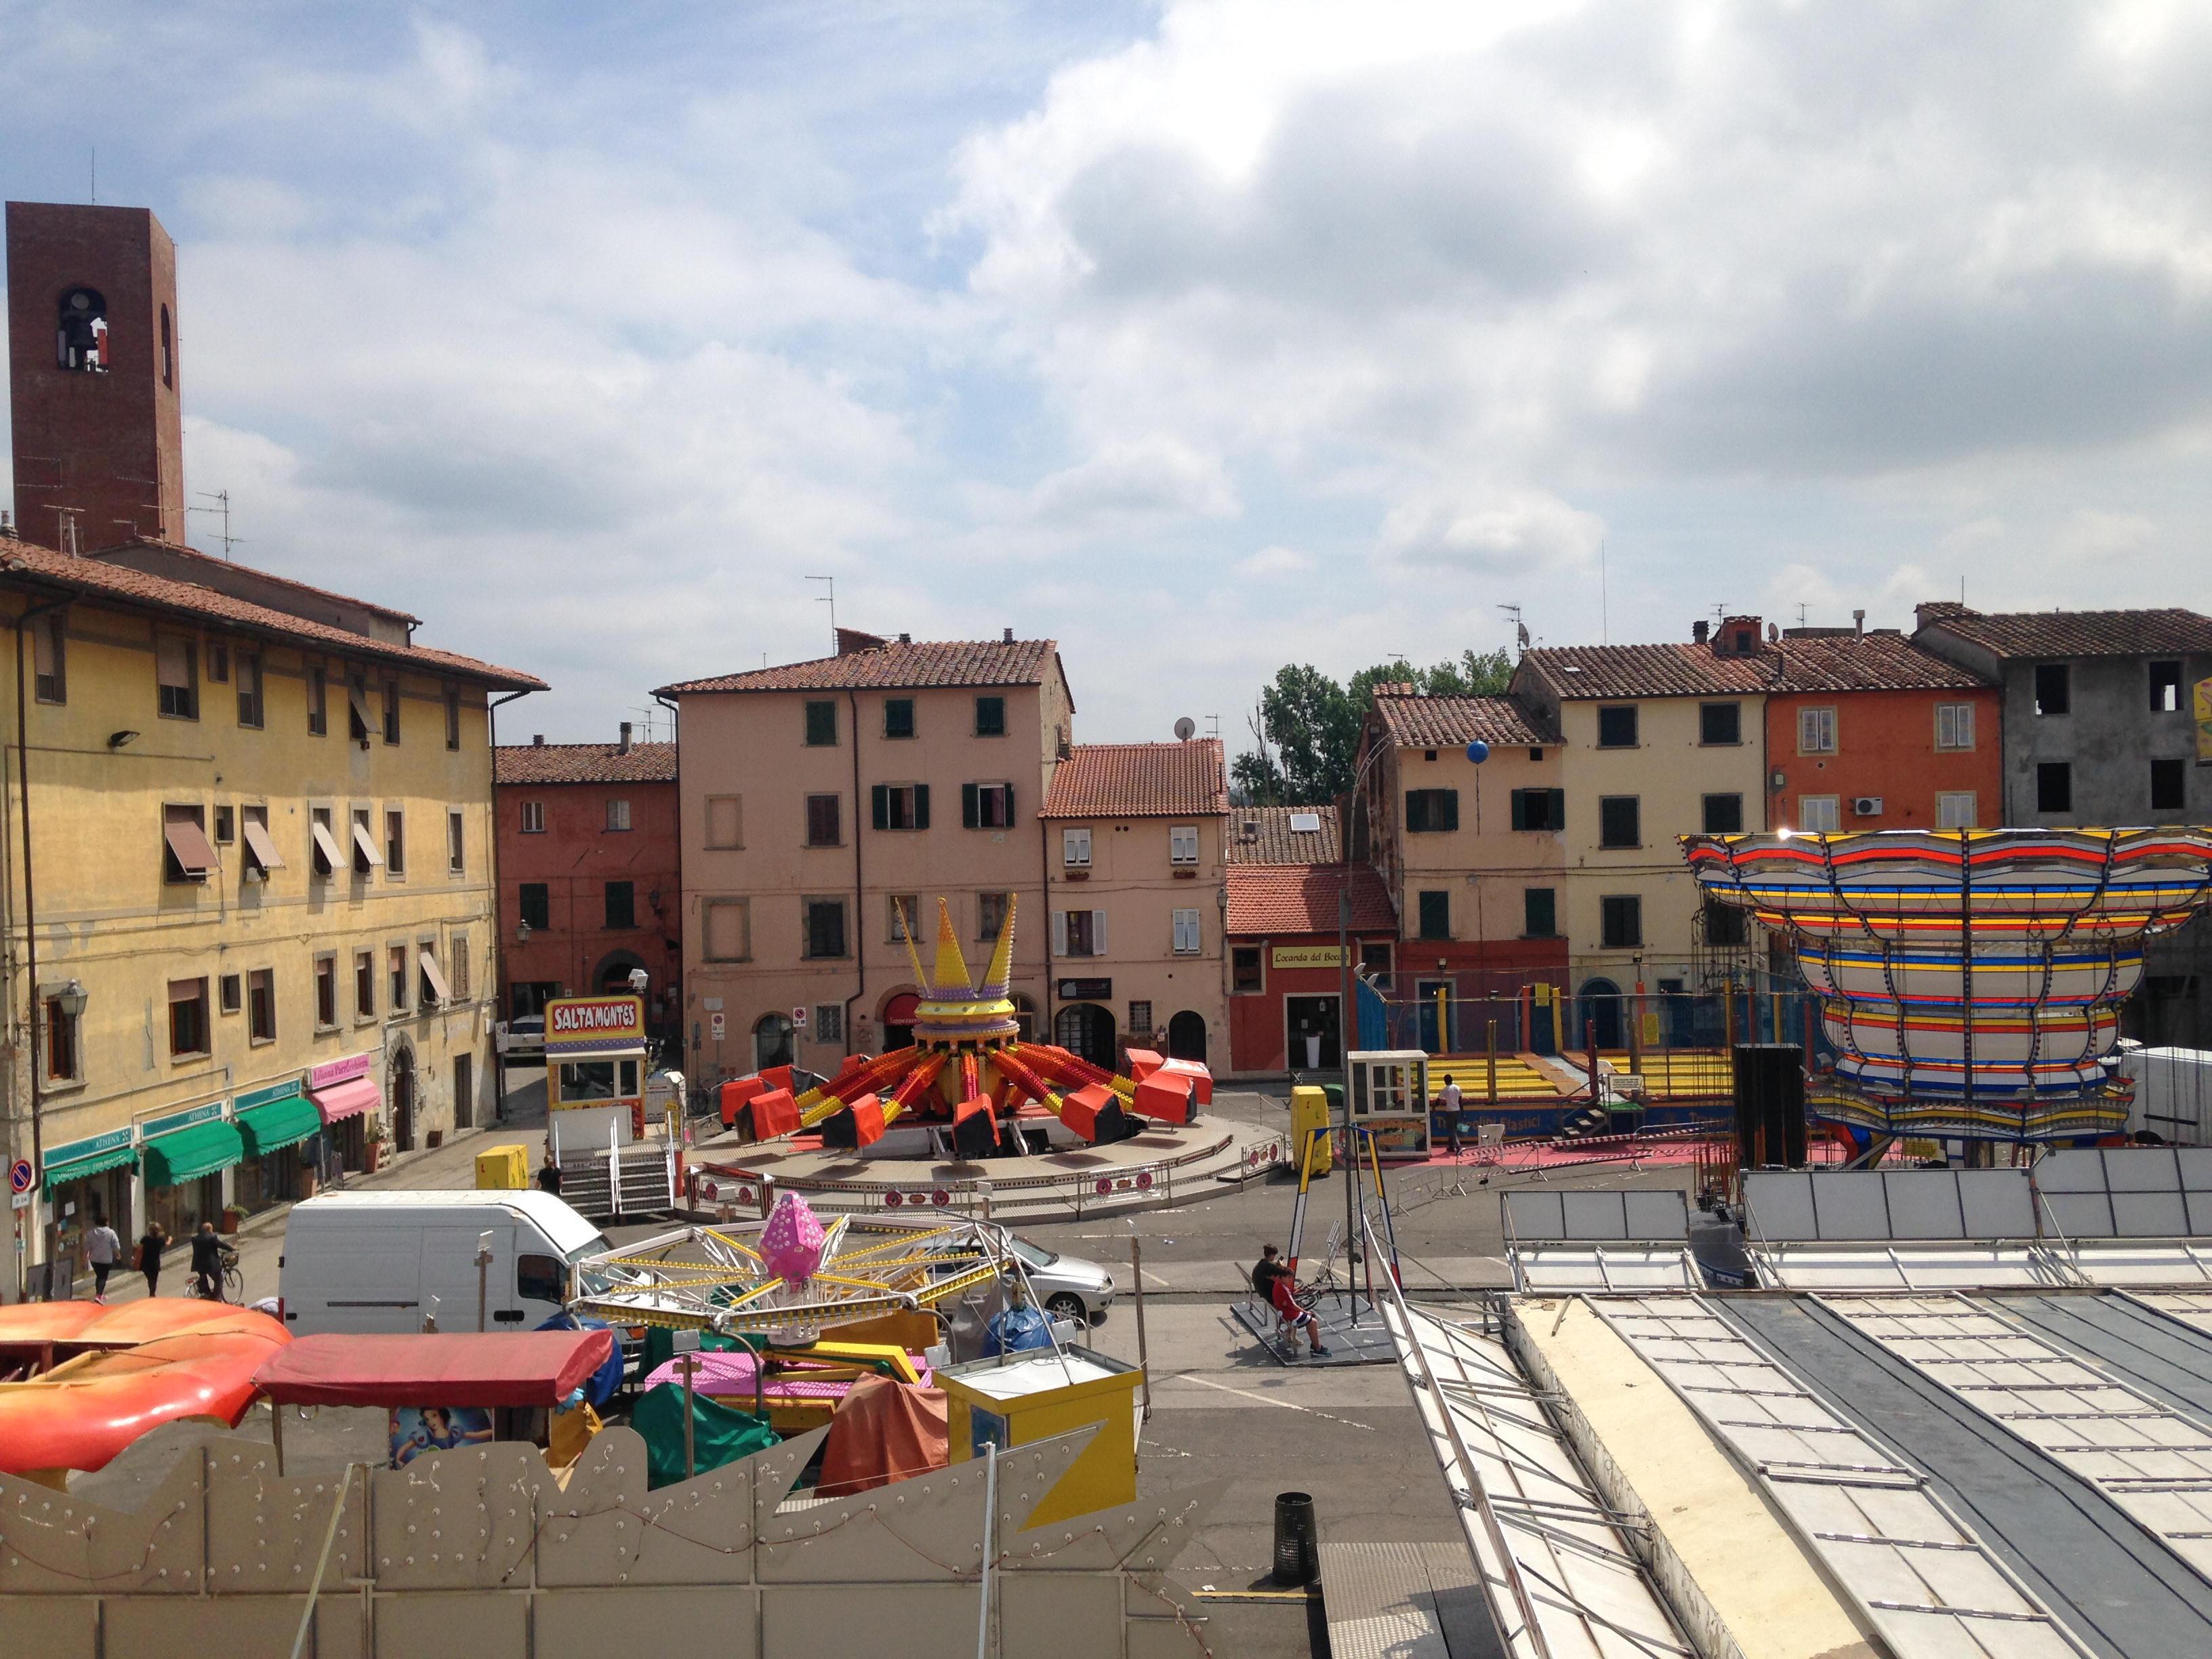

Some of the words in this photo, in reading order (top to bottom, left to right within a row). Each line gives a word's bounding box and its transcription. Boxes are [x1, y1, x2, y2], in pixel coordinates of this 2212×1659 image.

[1275, 953, 1307, 962] Locanda
[1310, 953, 1321, 961] del
[1324, 952, 1349, 961] Bocco
[554, 1004, 635, 1030] SALTAMONTES
[188, 1109, 210, 1122] ATHENA
[96, 1135, 120, 1149] ATHENA
